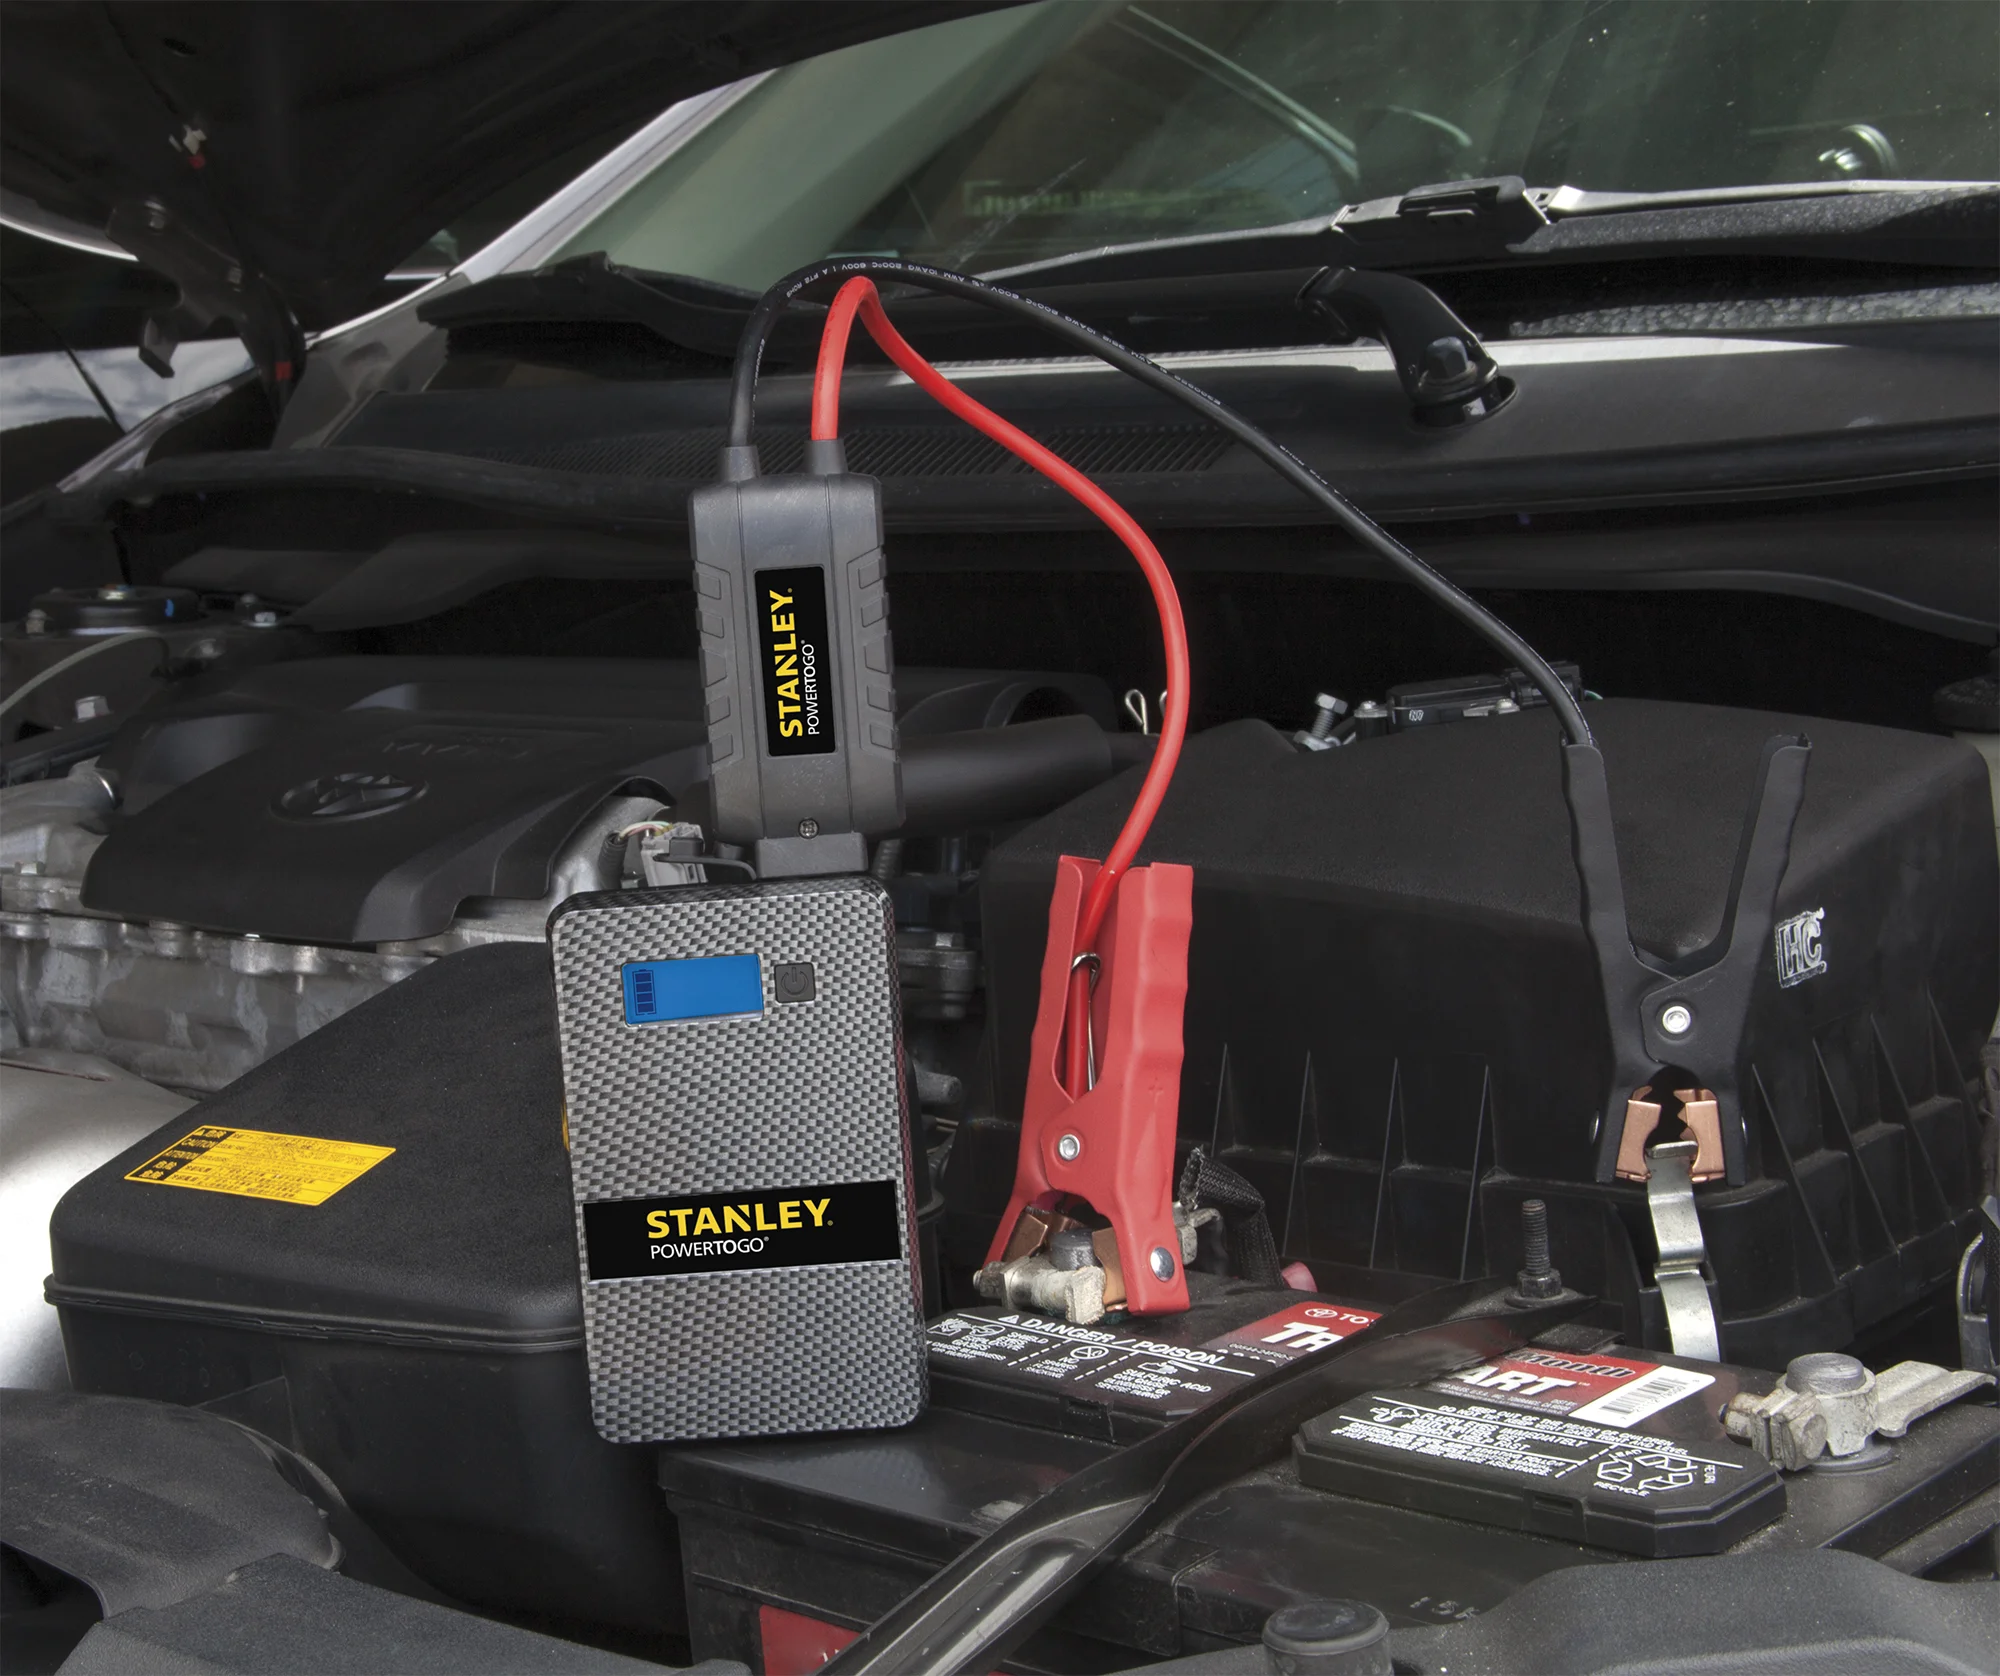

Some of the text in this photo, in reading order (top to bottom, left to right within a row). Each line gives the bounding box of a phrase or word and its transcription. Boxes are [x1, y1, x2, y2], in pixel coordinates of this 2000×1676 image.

[841, 262, 866, 270] 600V
[908, 264, 938, 276] 10AWG
[943, 271, 965, 282] AWM
[990, 286, 1019, 300] 600V
[1064, 315, 1096, 335] 10AWG
[769, 589, 803, 738] STANLEY
[802, 644, 820, 735] POWERTOGO
[646, 1198, 831, 1239] STANLEY
[650, 1237, 765, 1260] POWERTOGO
[1338, 1313, 1374, 1327] TO
[1020, 1318, 1115, 1344] DANGER
[1132, 1340, 1225, 1365] POISON
[1058, 1356, 1080, 1364] NO
[1122, 1368, 1212, 1393] SULFURIC ACID
[1411, 1418, 1447, 1429] WITH
[1496, 1433, 1526, 1443] GET
[1419, 1412, 1589, 1447] FLUSH EYES IMMEDIATELY
[1438, 1405, 1457, 1413] DO
[1456, 1408, 1482, 1417] NOT
[1503, 1417, 1534, 1426] KEEP
[1534, 1422, 1564, 1431] VENT
[1563, 1428, 1597, 1438] CAPS
[1595, 1433, 1630, 1443] TIGHT
[1628, 1440, 1655, 1448] AND
[1654, 1444, 1689, 1456] LEVEL
[1467, 1405, 1497, 1414] KEEP
[1497, 1411, 1522, 1419] OUT
[1540, 1418, 1563, 1427] THE
[1562, 1422, 1601, 1434] REACH
[1400, 1422, 1531, 1451] MEDICAL HELP FAST
[1593, 1481, 1650, 1497] RECYCLE
